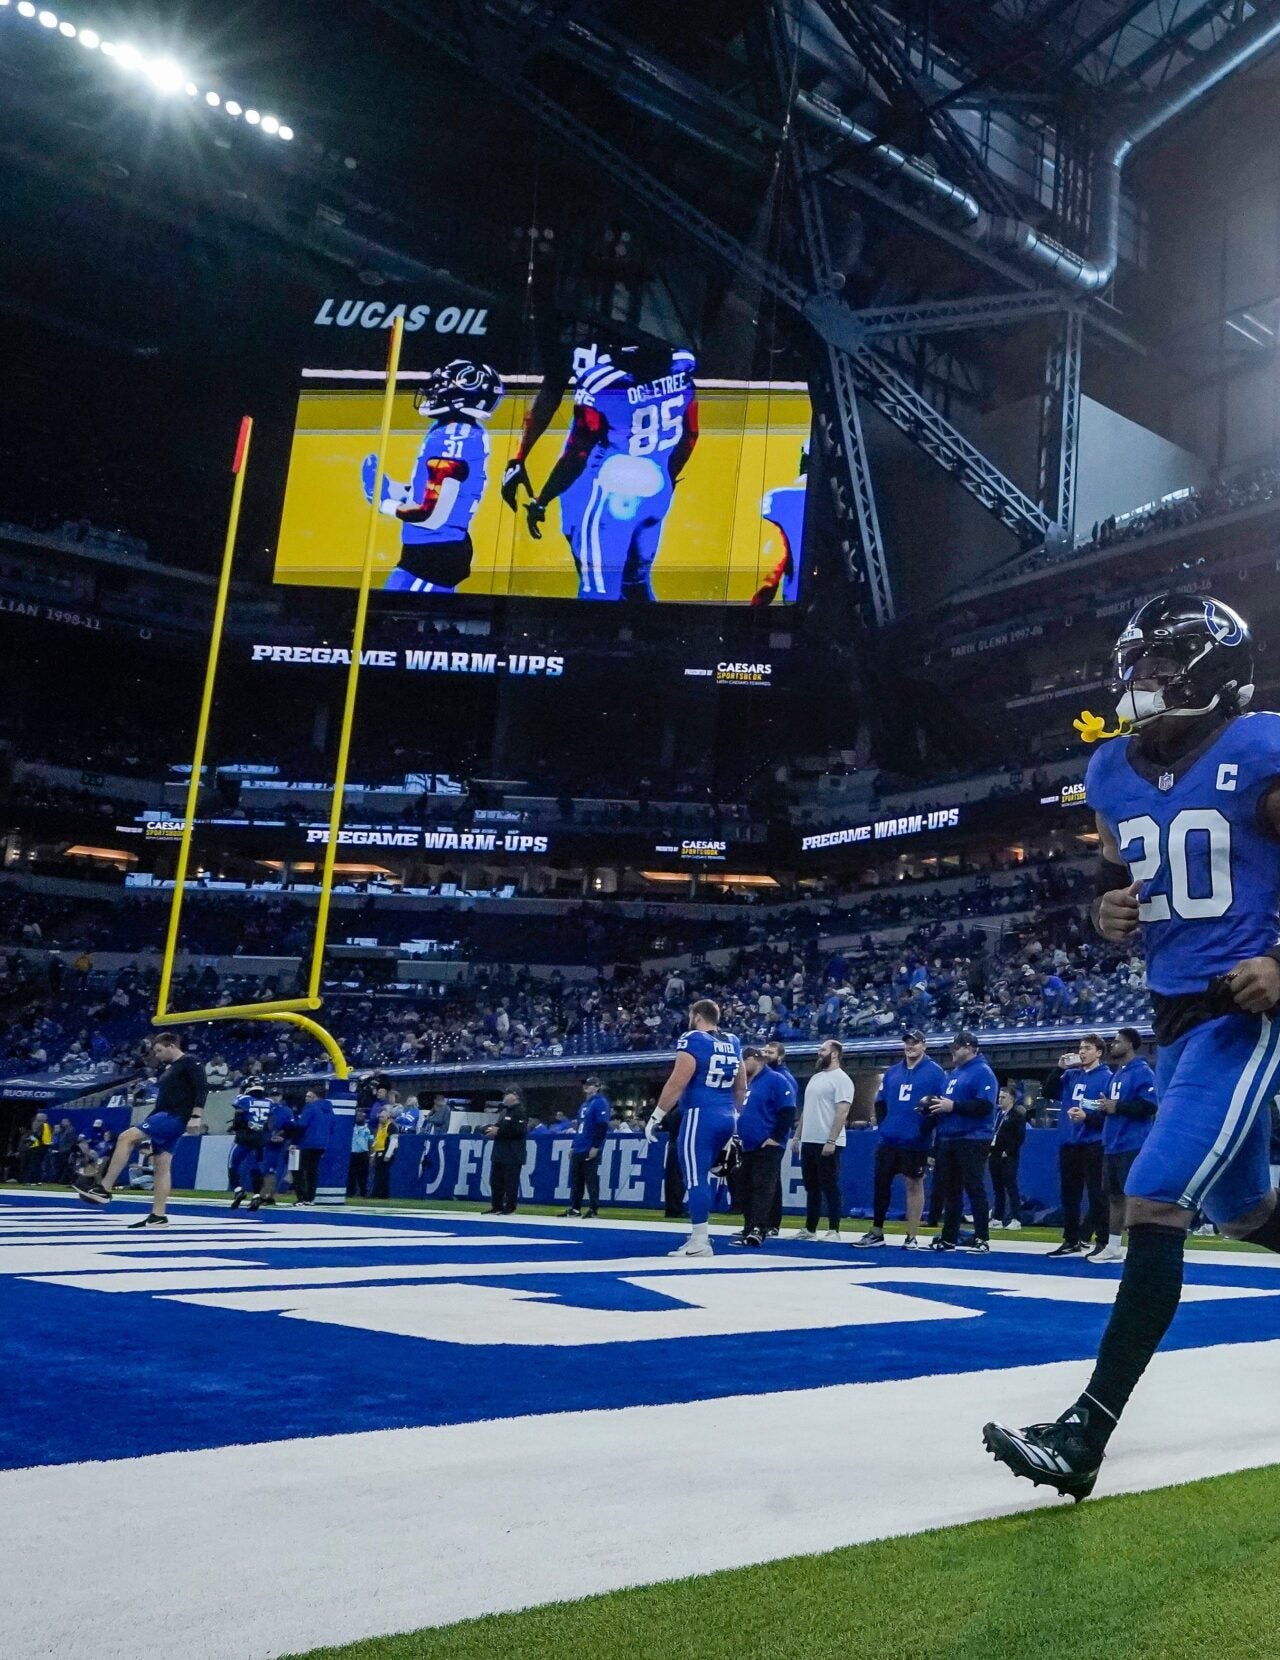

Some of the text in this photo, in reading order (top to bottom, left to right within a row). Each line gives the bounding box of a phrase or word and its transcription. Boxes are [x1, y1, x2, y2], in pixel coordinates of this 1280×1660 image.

[314, 299, 488, 335] LUCAS OIL
[629, 394, 685, 457] 85
[441, 439, 464, 459] 31
[251, 645, 565, 676] PREGAME WARM-UPS
[717, 662, 772, 675] CAESARS
[1216, 763, 1239, 792] C
[801, 808, 959, 850] PREGAME WARM-UPS
[424, 832, 549, 853] WARM-UPS
[681, 840, 727, 850] CAESARS
[1117, 809, 1233, 922] 20
[2, 1088, 56, 1099] RUOFF.COM
[898, 1083, 913, 1101] C
